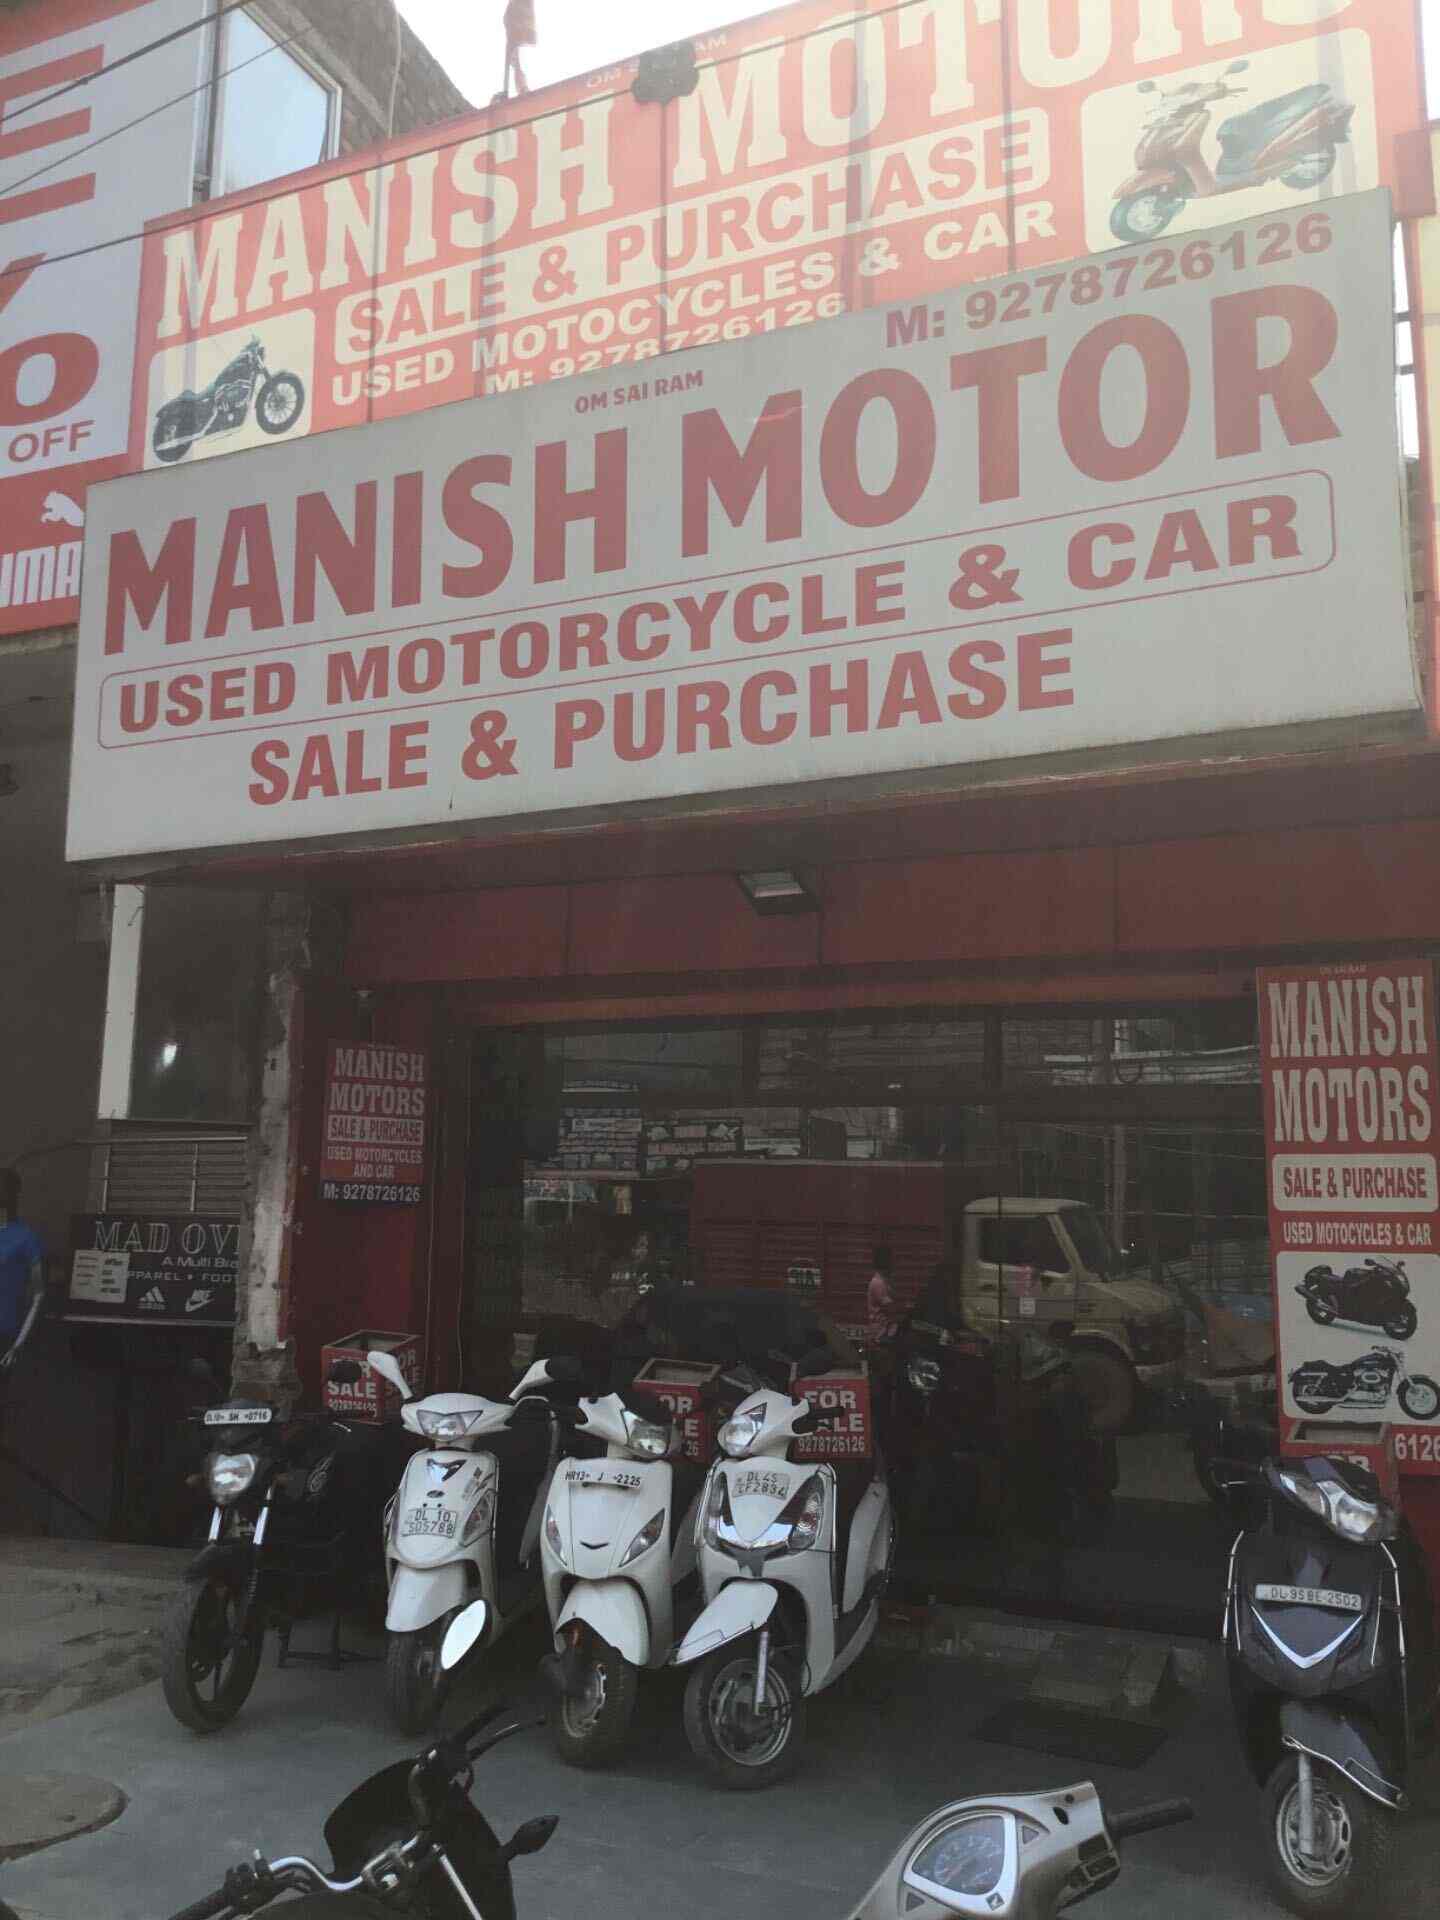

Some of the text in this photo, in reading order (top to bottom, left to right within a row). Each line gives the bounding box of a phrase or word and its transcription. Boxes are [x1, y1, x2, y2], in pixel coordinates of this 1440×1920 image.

[156, 87, 616, 339] MANISH
[350, 119, 1031, 356] SALE & PURCHASE
[887, 212, 1333, 347] M: 9278726126
[333, 201, 1056, 406] USED MOTOCYCLES & CAR
[550, 292, 845, 380] 9278726126
[575, 370, 704, 414] OM SAI RAM
[9, 420, 95, 463] OFF
[105, 284, 1342, 656] MANISH MOTOR
[120, 494, 1302, 733] USED MOTORCYCLE & CAR
[249, 628, 1074, 805] SALE & PURCHASE
[1267, 976, 1427, 1058] MANISH
[335, 1047, 424, 1082] MANISH
[330, 1082, 425, 1116] MOTORS
[1272, 1065, 1431, 1142] MOTORS
[327, 1146, 352, 1160] USED
[376, 1164, 395, 1178] CAR
[343, 1184, 421, 1201] 9278726126
[1283, 1166, 1428, 1199] SALE & PURCHASE
[92, 1221, 170, 1253] MAD
[1283, 1222, 1433, 1246] USED MOTOCYCLES & CAR
[127, 1270, 183, 1281] PPAREL
[161, 1256, 174, 1267] A
[327, 1380, 377, 1399] SALE
[804, 1390, 856, 1410] FOR
